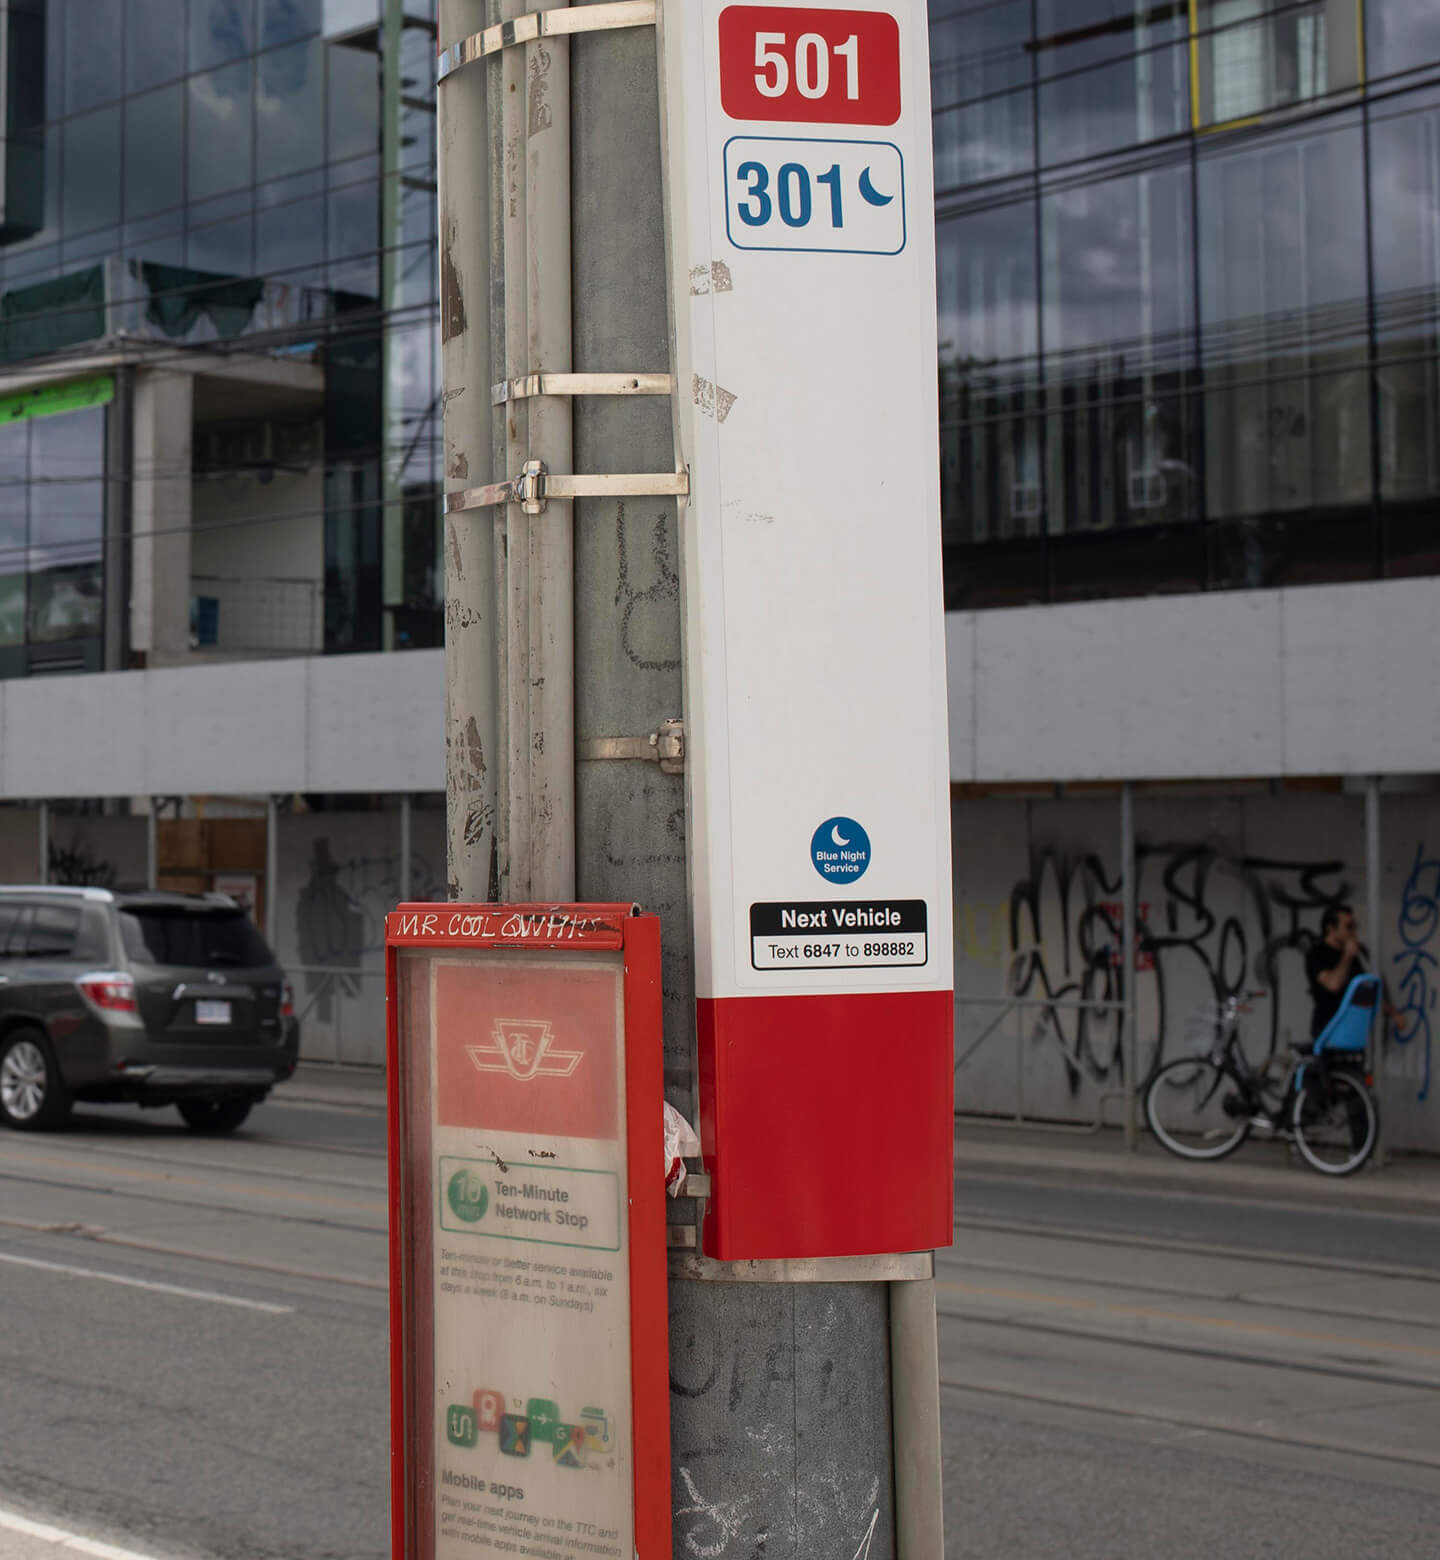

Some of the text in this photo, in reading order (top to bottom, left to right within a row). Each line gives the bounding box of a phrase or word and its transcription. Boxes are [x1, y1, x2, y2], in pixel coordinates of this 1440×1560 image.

[754, 31, 860, 101] 501
[736, 161, 844, 229] 301
[816, 850, 866, 863] Blue Night
[823, 863, 859, 873] Service
[781, 908, 902, 928] Next Vehicle
[768, 942, 915, 959] Text 6847 to 898882
[495, 1181, 569, 1203] Ten-Minute
[495, 1203, 589, 1230] Network Stop
[533, 1263, 568, 1276] service
[546, 1279, 556, 1290] to
[534, 1294, 546, 1305] on
[441, 1470, 525, 1501] Mobile apps
[504, 1508, 540, 1526] journey
[542, 1517, 556, 1528] on
[557, 1518, 573, 1532] the
[575, 1521, 597, 1535] TTC
[599, 1526, 619, 1540] and
[493, 1538, 517, 1553] apps
[499, 1523, 531, 1539] vehicle
[565, 1535, 623, 1558] information
